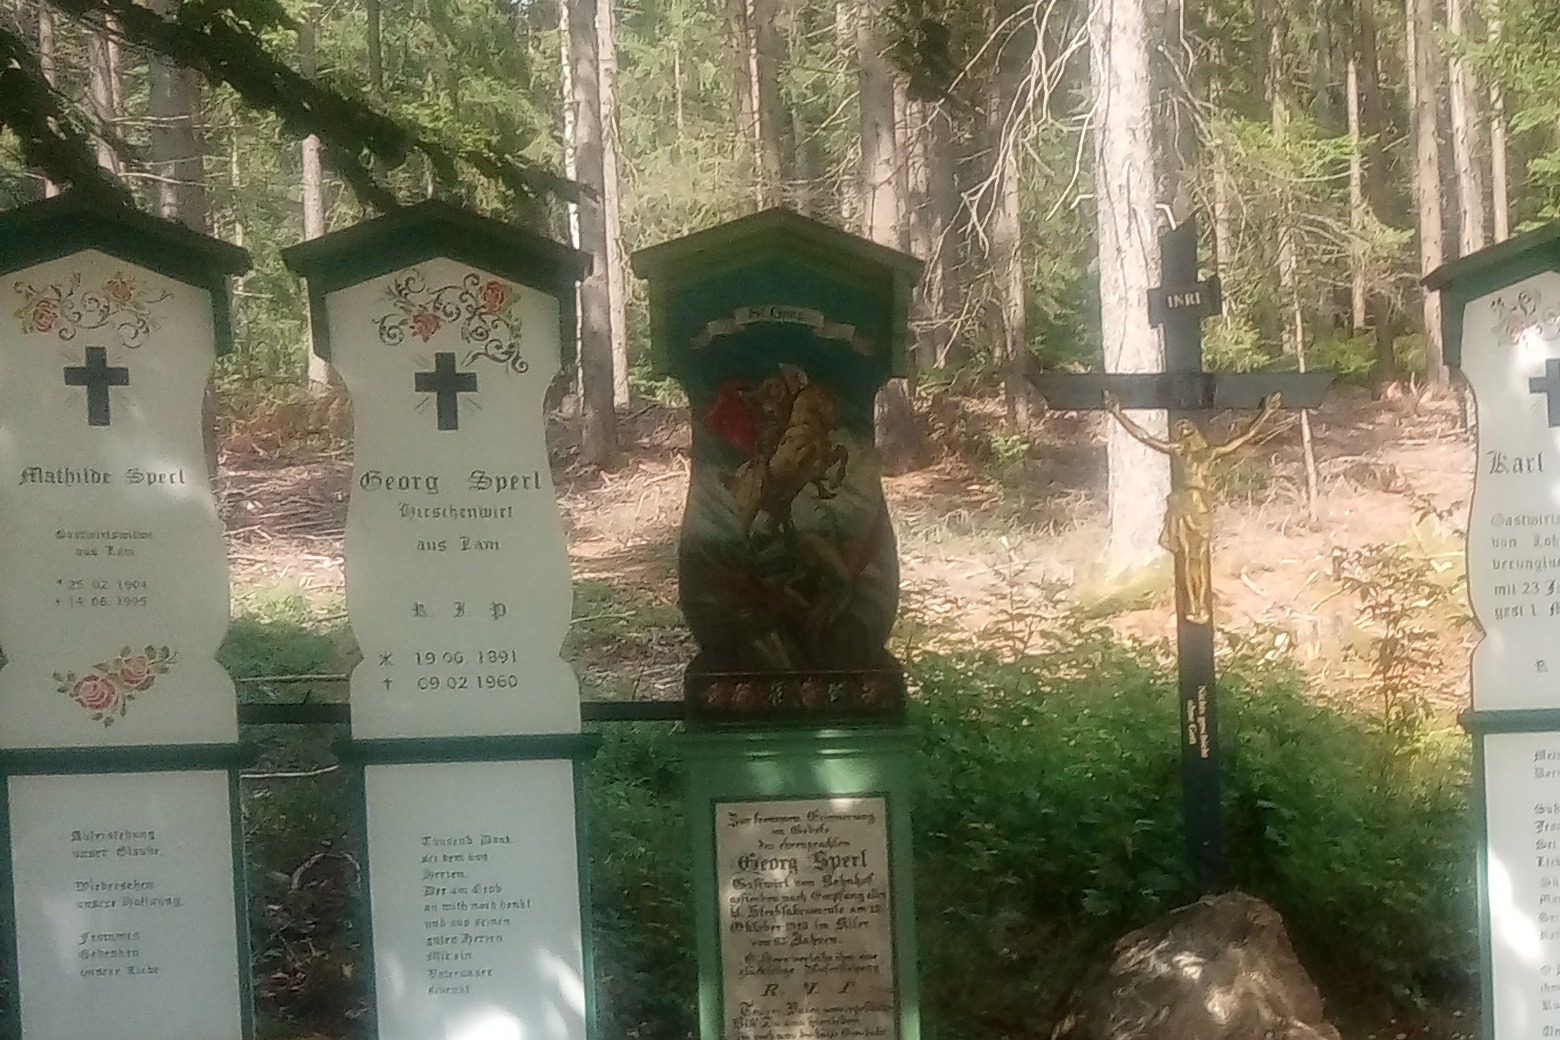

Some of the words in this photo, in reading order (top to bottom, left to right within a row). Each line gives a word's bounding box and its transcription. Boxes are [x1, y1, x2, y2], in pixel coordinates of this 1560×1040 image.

[1167, 291, 1200, 309] INRI
[1487, 450, 1543, 475] Karl
[19, 466, 112, 487] Mathilde
[126, 468, 186, 487] Sperl
[360, 470, 440, 494] Georg
[469, 470, 543, 493] Sperl
[399, 502, 514, 520] Hirschenwirt
[417, 539, 448, 552] aus
[459, 536, 500, 551] Lam
[1492, 537, 1517, 548] von
[1494, 583, 1516, 596] mit
[1522, 581, 1540, 595] 23
[476, 675, 518, 689] 1960
[737, 852, 798, 874] Georg
[813, 849, 868, 874] Sperl
